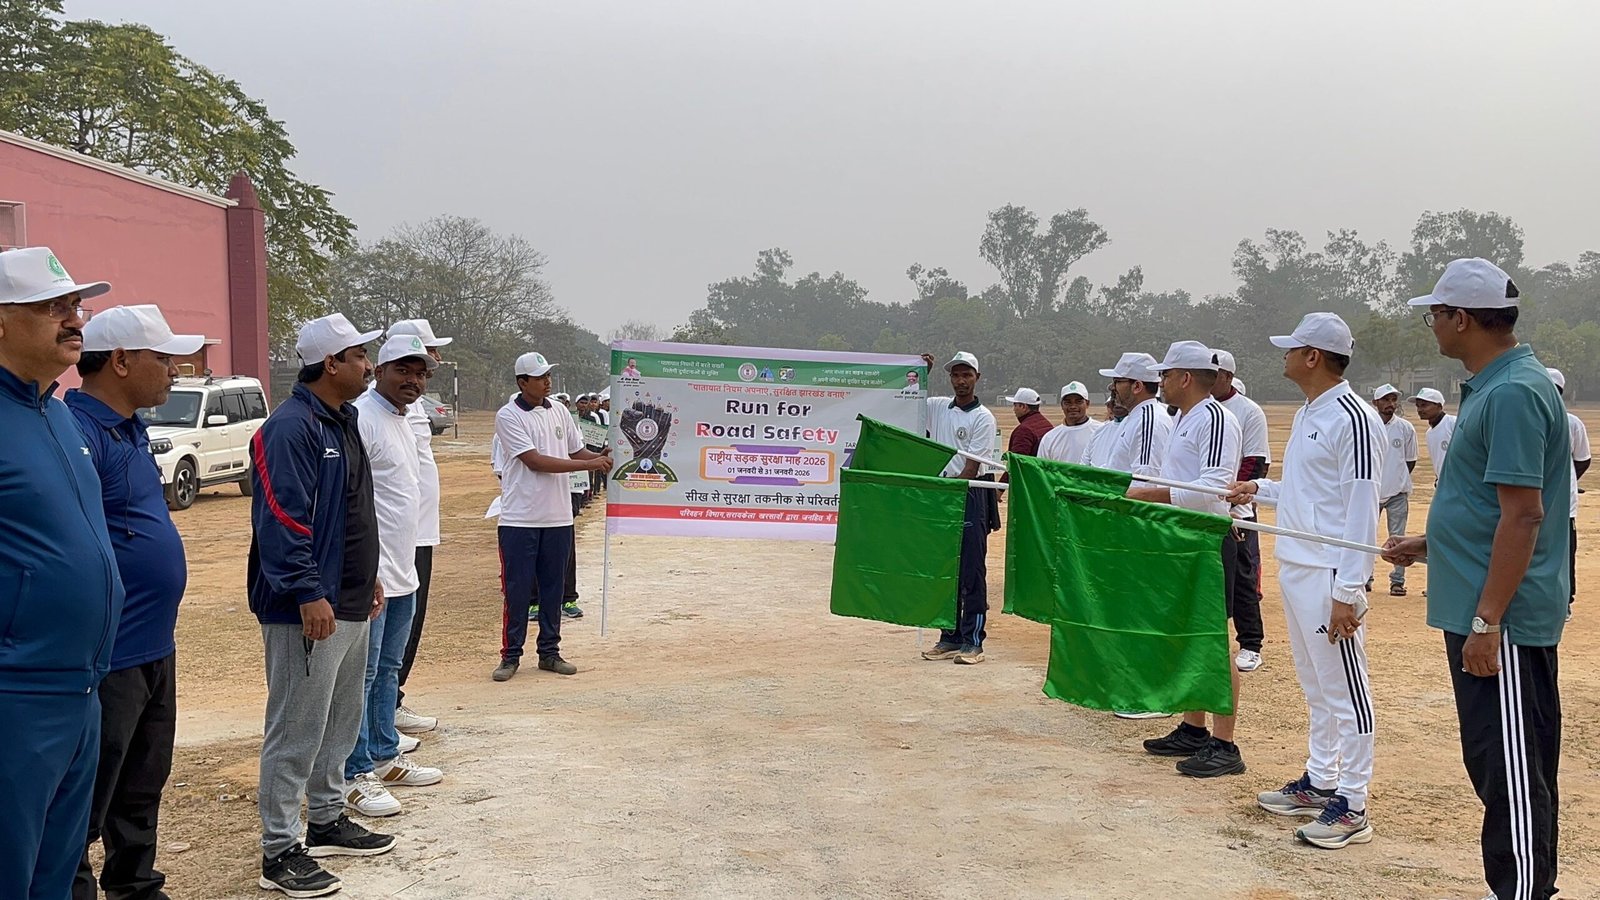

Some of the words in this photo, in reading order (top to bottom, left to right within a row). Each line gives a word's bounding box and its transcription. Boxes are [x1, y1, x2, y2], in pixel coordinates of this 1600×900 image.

[723, 384, 742, 393] नियम
[726, 400, 769, 414] Run
[777, 401, 811, 416] for
[696, 422, 755, 438] Road
[764, 425, 838, 443] Safety
[708, 451, 732, 465] राष्ट्रीय
[734, 453, 758, 465] सड़क
[760, 454, 783, 466] सुरक्षा
[784, 455, 801, 466] माह
[803, 456, 826, 466] 2026
[737, 466, 757, 474] जनवरी
[757, 466, 764, 474] से
[685, 489, 709, 502] सीख
[711, 490, 721, 502] से
[723, 492, 750, 506] सुरक्षा
[754, 491, 793, 505] तकनीक
[795, 492, 805, 505] से
